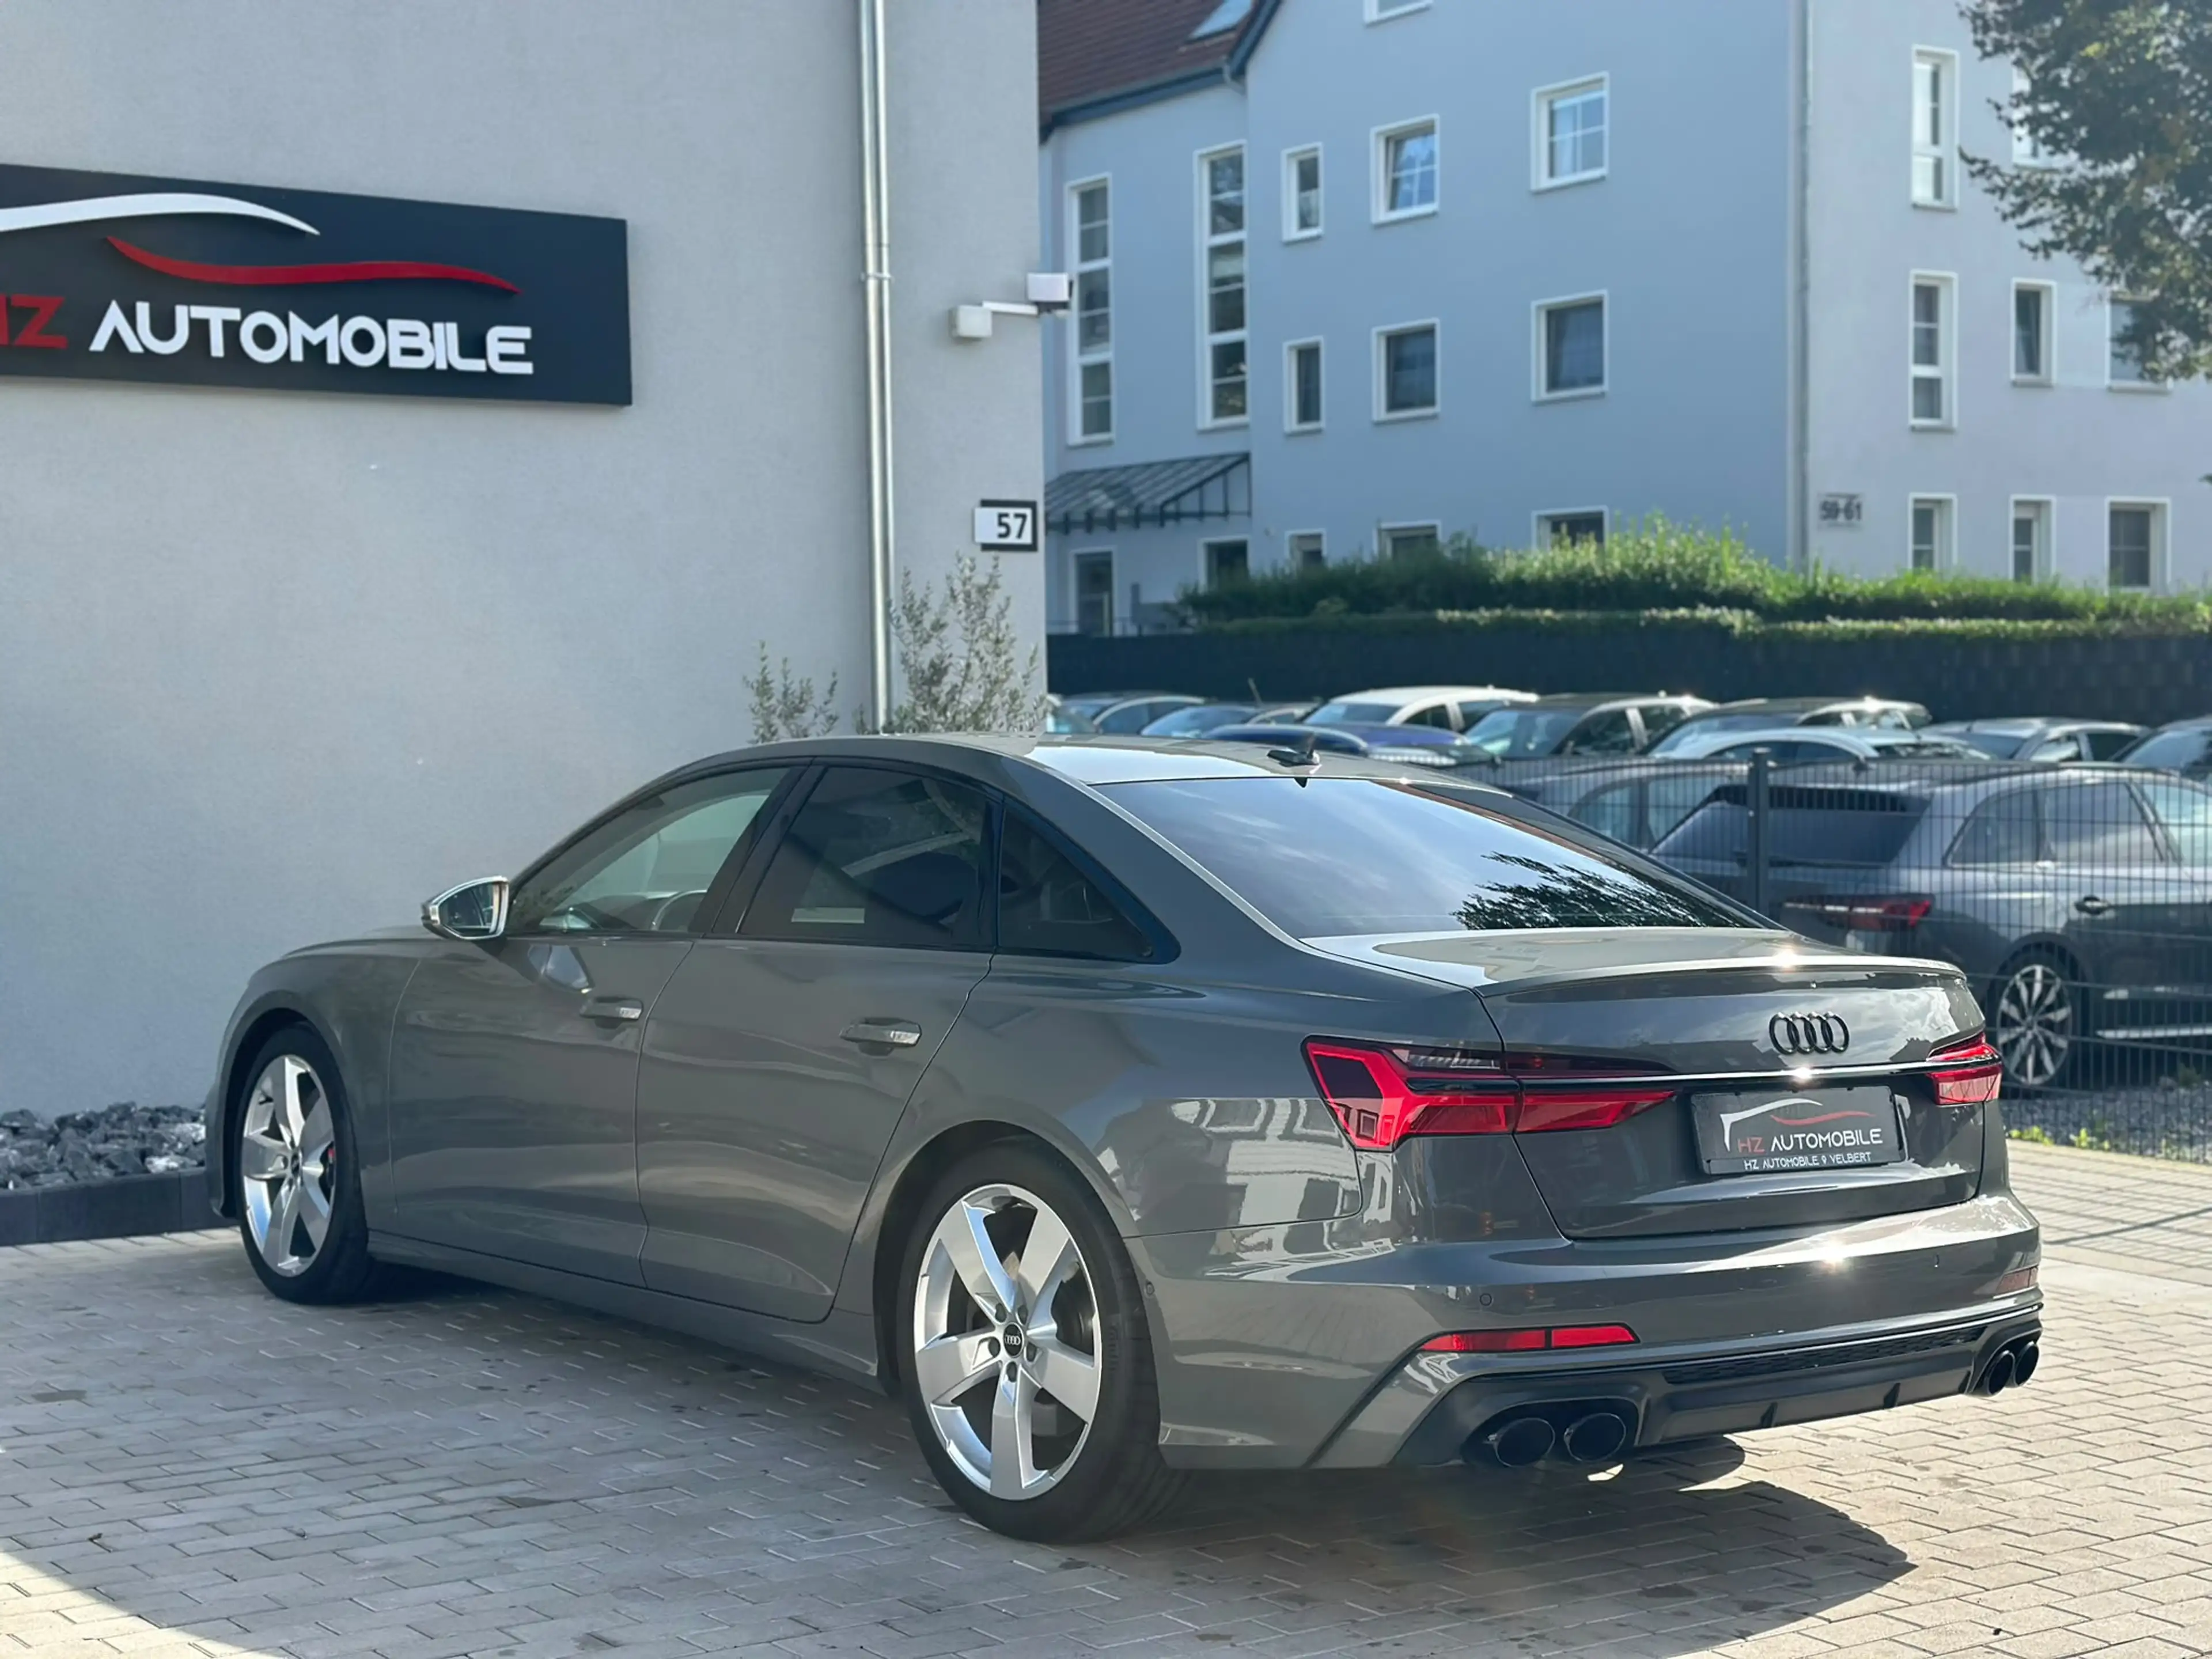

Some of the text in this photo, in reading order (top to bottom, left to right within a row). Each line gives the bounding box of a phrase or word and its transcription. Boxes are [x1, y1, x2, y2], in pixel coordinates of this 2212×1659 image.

[0, 293, 534, 374] Z AUTOMOBILE
[997, 512, 1027, 539] 57
[1737, 1128, 1883, 1154] HZ AUTOMOBILE
[1744, 1152, 1872, 1171] HZ AUTOMOBILE VELBERT
